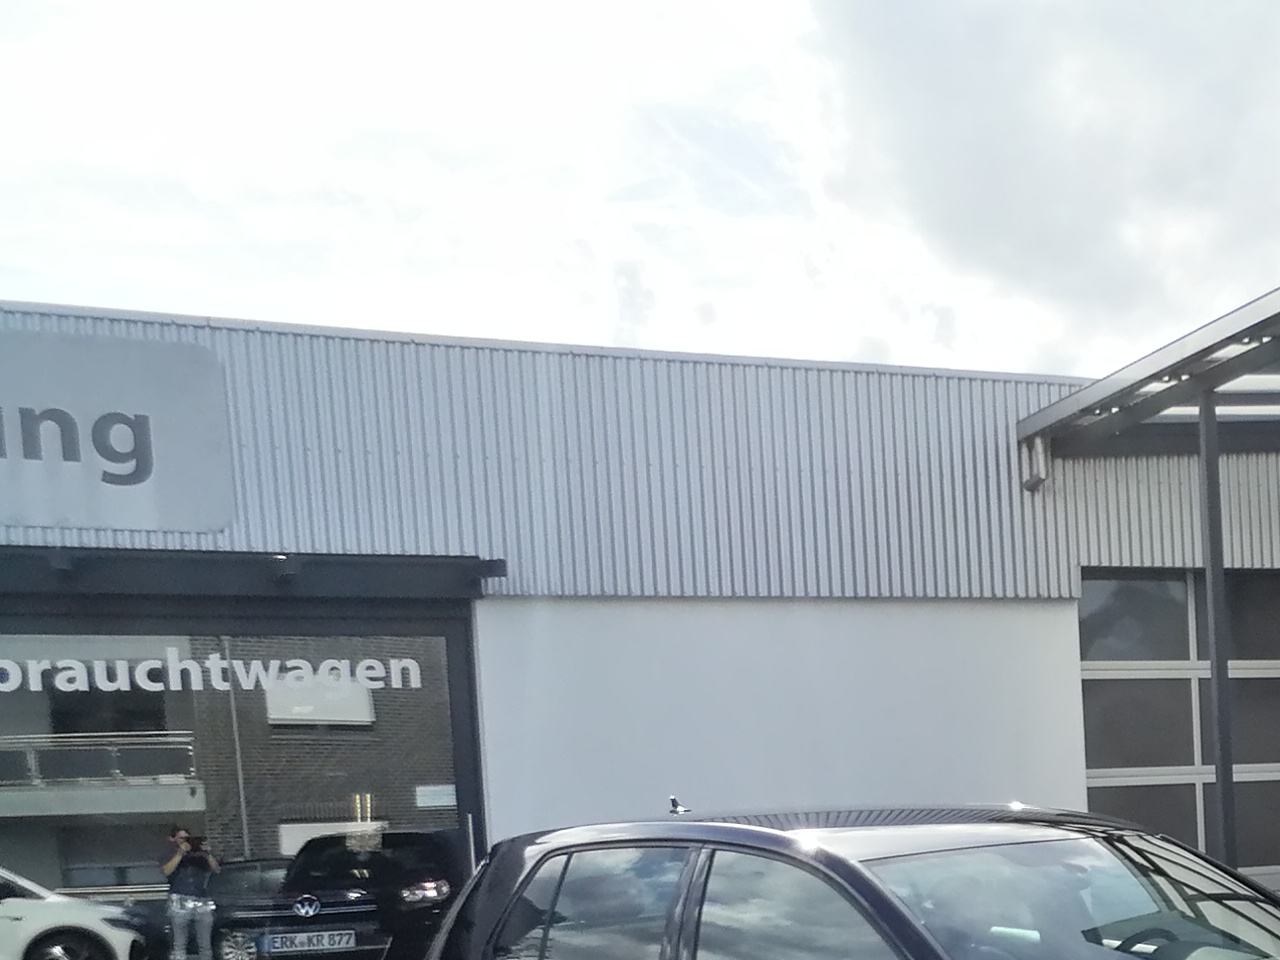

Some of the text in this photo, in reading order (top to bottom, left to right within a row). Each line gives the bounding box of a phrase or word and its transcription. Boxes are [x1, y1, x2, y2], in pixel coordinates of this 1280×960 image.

[0, 407, 154, 486] ng
[271, 935, 299, 950] ERK
[327, 932, 353, 946] 877
